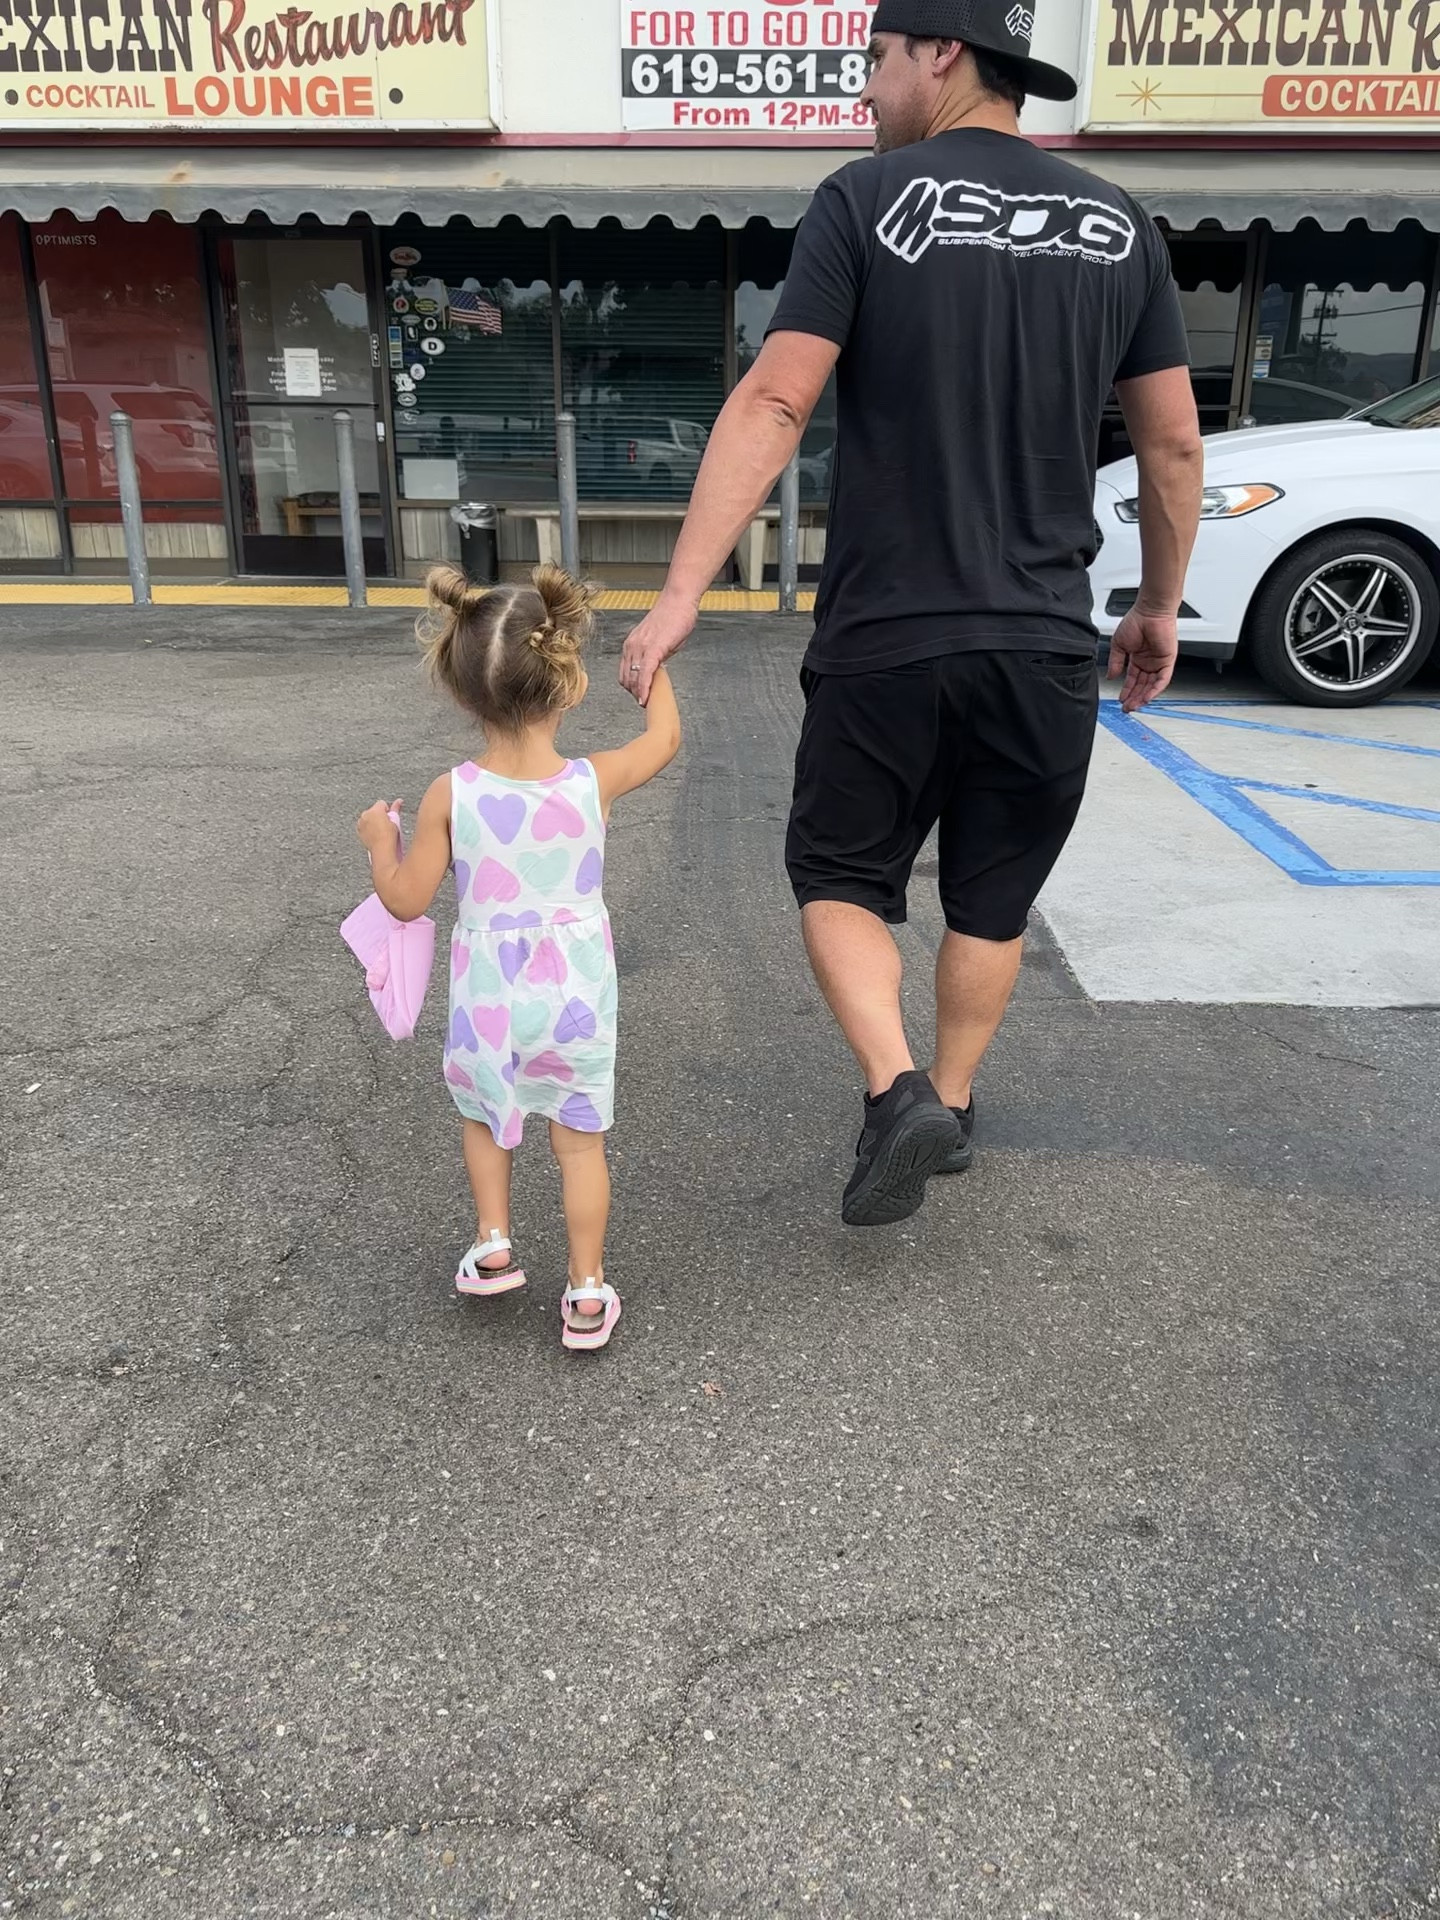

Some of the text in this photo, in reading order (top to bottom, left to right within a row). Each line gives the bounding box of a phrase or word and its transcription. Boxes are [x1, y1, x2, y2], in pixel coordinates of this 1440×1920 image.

[203, 0, 475, 73] Restaurant
[631, 11, 875, 46] FOR TO GO OR
[1108, 0, 1400, 66] MEXICAN
[631, 53, 873, 94] 619-561-8
[26, 76, 374, 116] COCKTAIL LOUNGE
[674, 101, 877, 125] From 12PM-8
[36, 234, 97, 245] OPTIMISTS
[937, 238, 1113, 266] SUSPENSION DVELOPMENT GROUP
[428, 341, 438, 351] D
